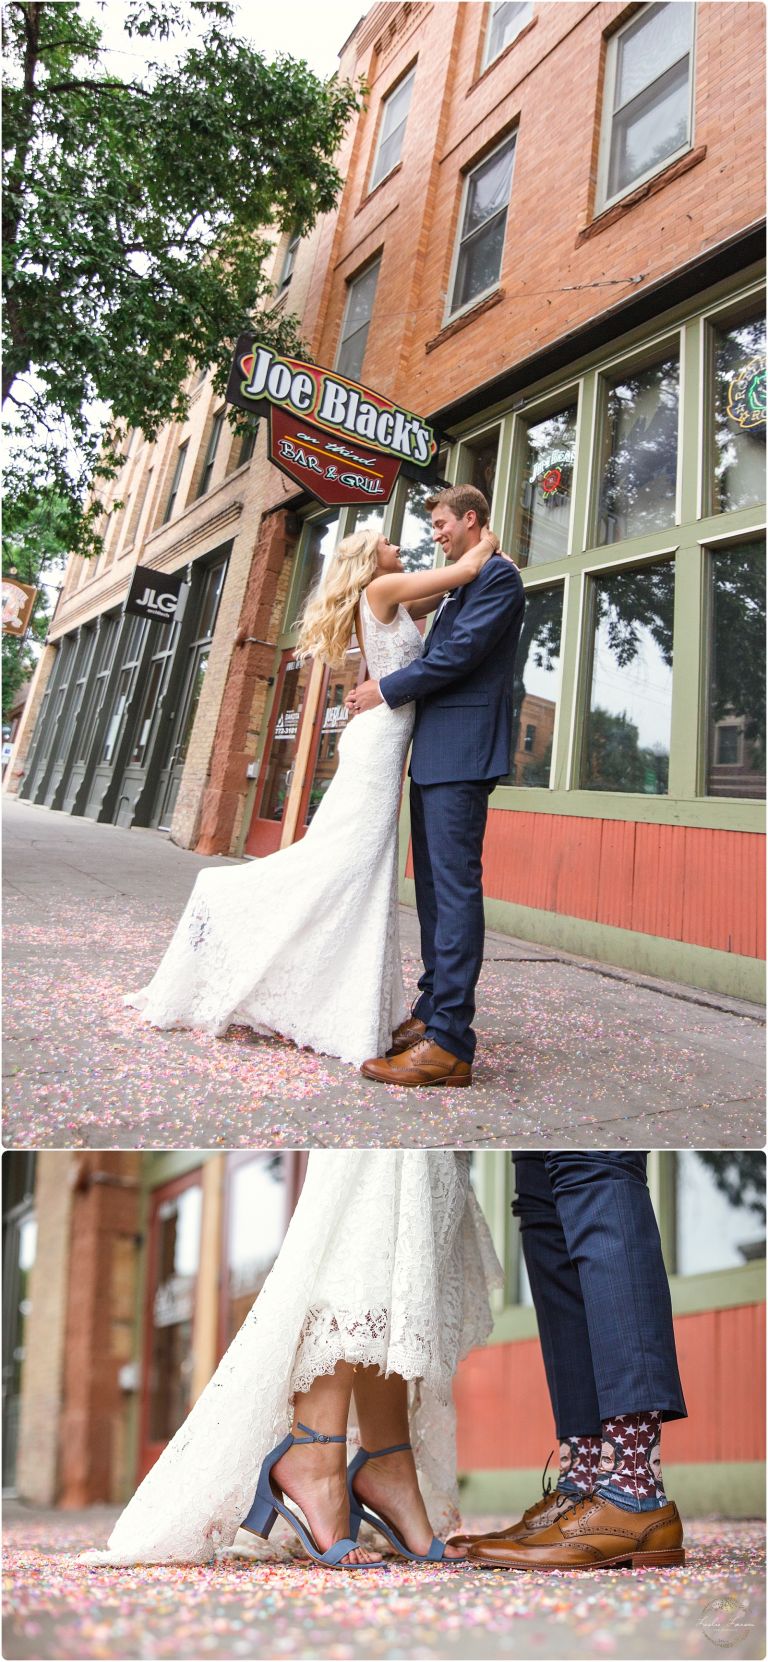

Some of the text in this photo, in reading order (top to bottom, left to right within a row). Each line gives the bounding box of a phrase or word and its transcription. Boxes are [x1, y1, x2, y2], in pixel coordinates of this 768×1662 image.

[246, 348, 430, 462] Joe Black's
[279, 441, 385, 495] BAR & GRILL
[297, 432, 376, 466] on third
[135, 588, 178, 613] JLG
